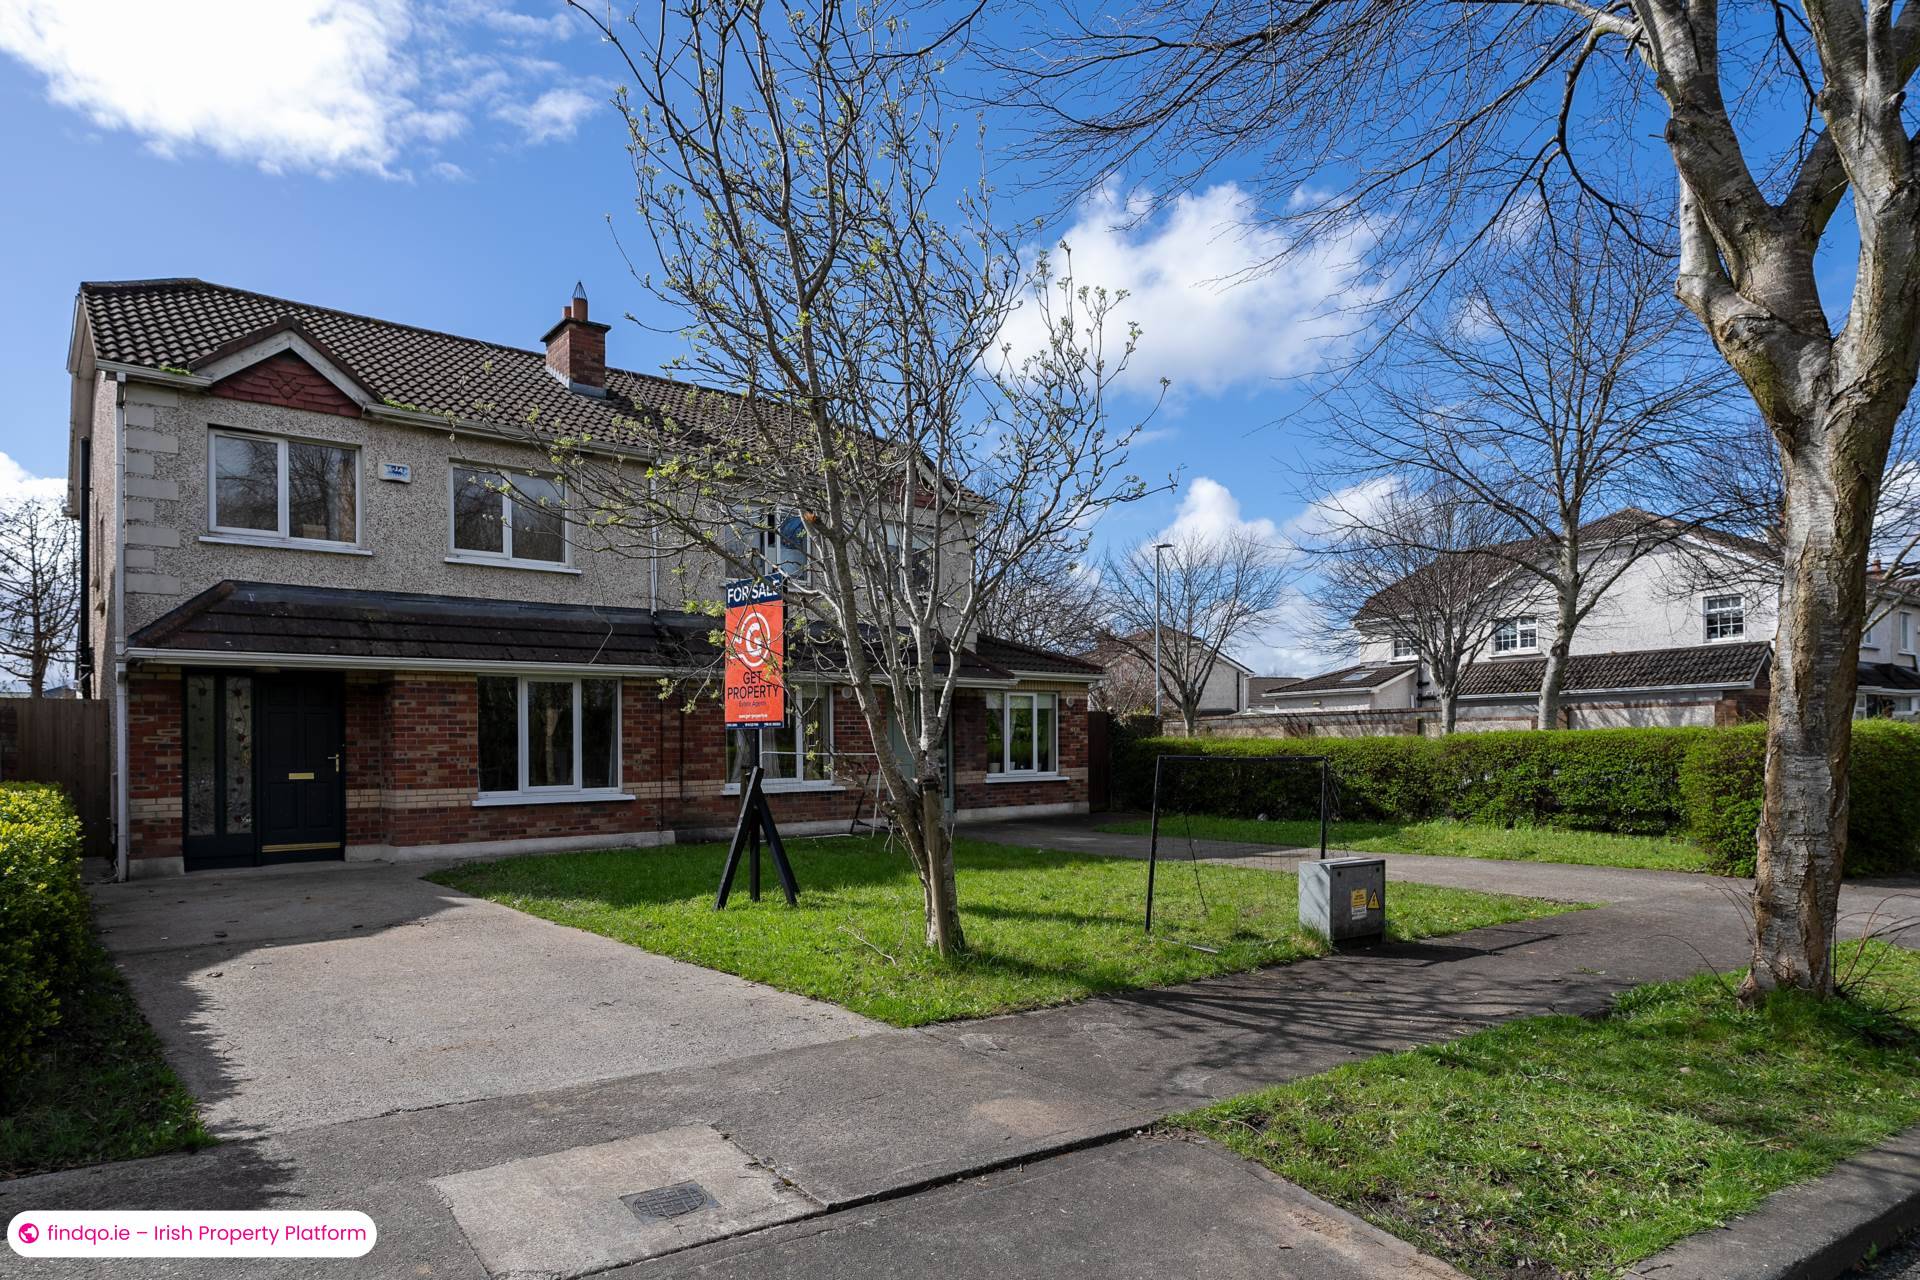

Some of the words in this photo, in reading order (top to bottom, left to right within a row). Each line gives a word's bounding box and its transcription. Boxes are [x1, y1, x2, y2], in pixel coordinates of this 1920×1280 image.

[727, 585, 750, 604] FOR
[743, 670, 763, 685] GET
[727, 684, 779, 700] PROPERTY
